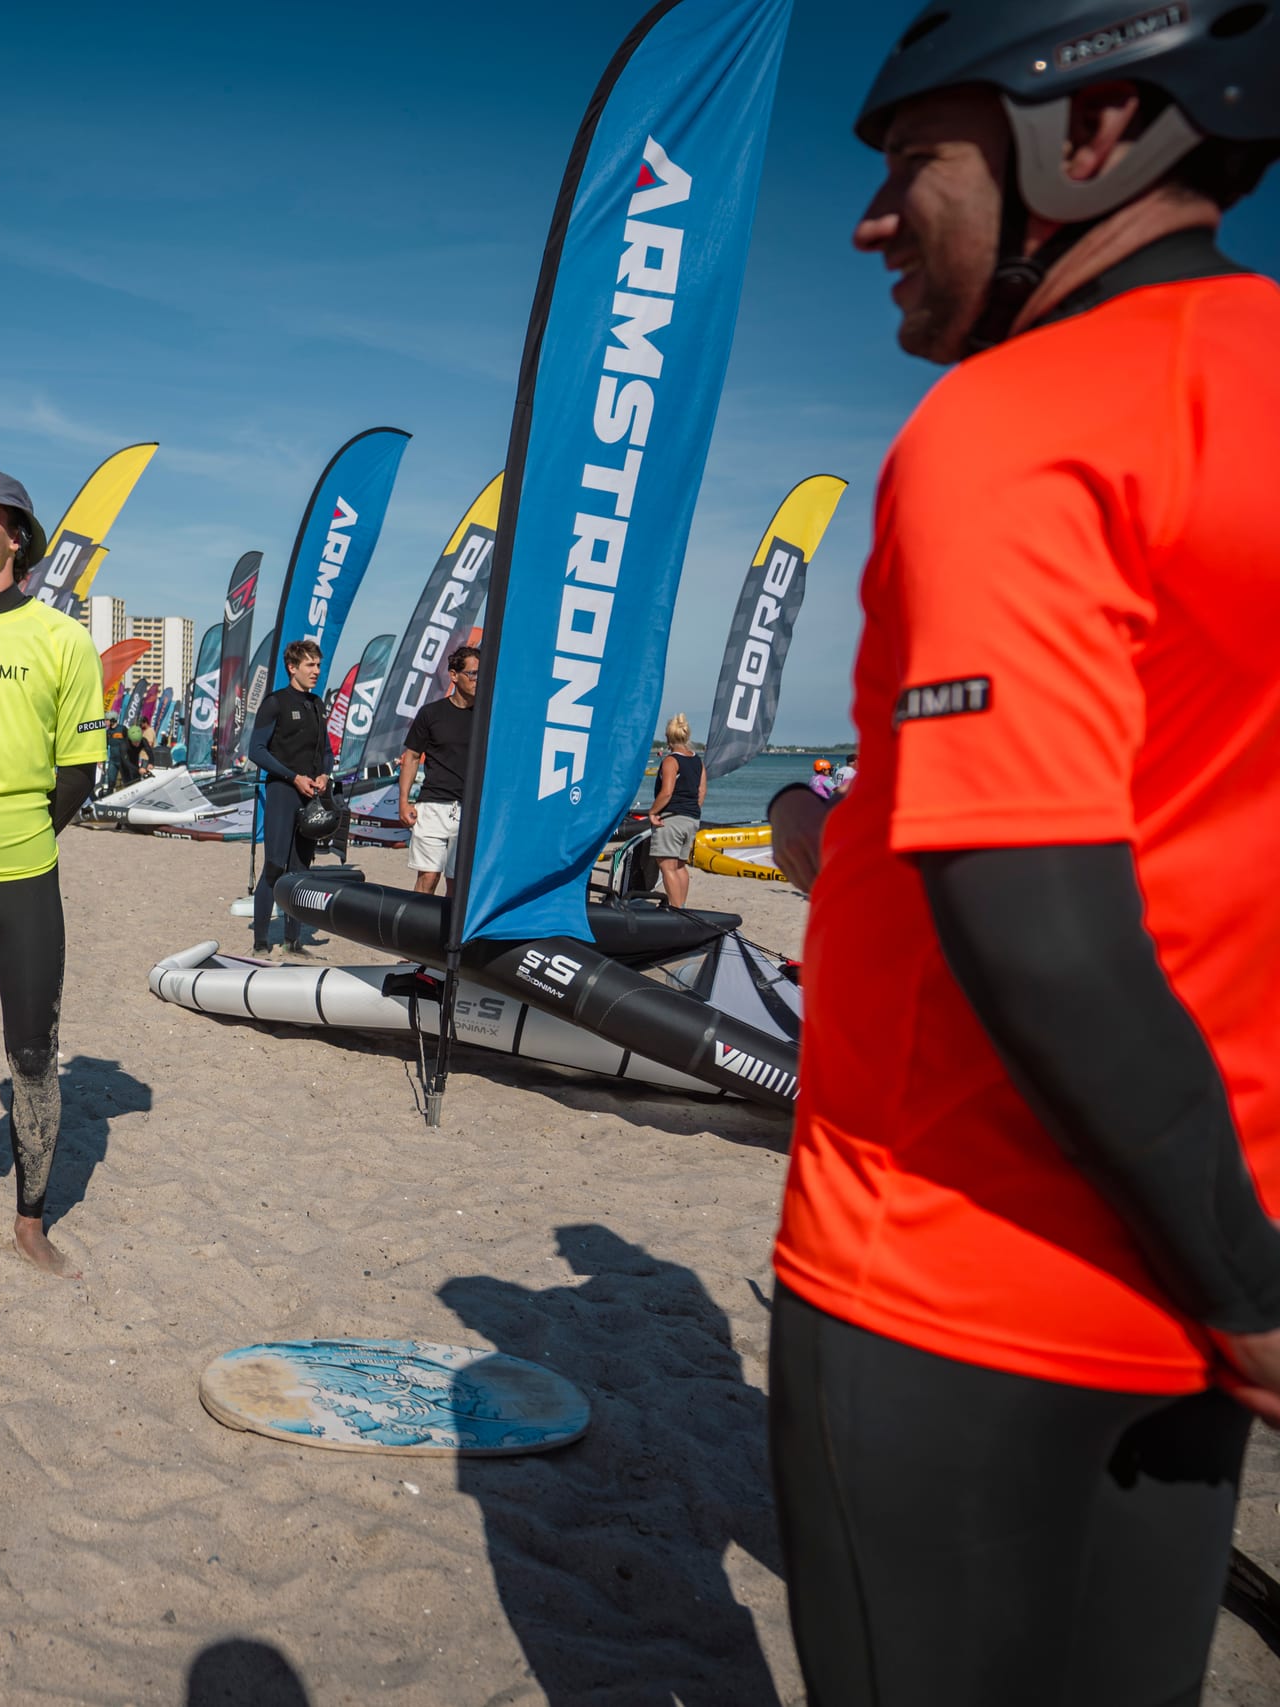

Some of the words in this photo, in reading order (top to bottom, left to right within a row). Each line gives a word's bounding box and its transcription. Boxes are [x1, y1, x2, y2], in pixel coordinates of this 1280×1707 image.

[1059, 5, 1185, 66] PROLIMIT
[538, 134, 693, 800] ARMSTRONG
[346, 677, 385, 736] GA
[395, 533, 495, 720] CORE
[726, 548, 800, 733] CORE
